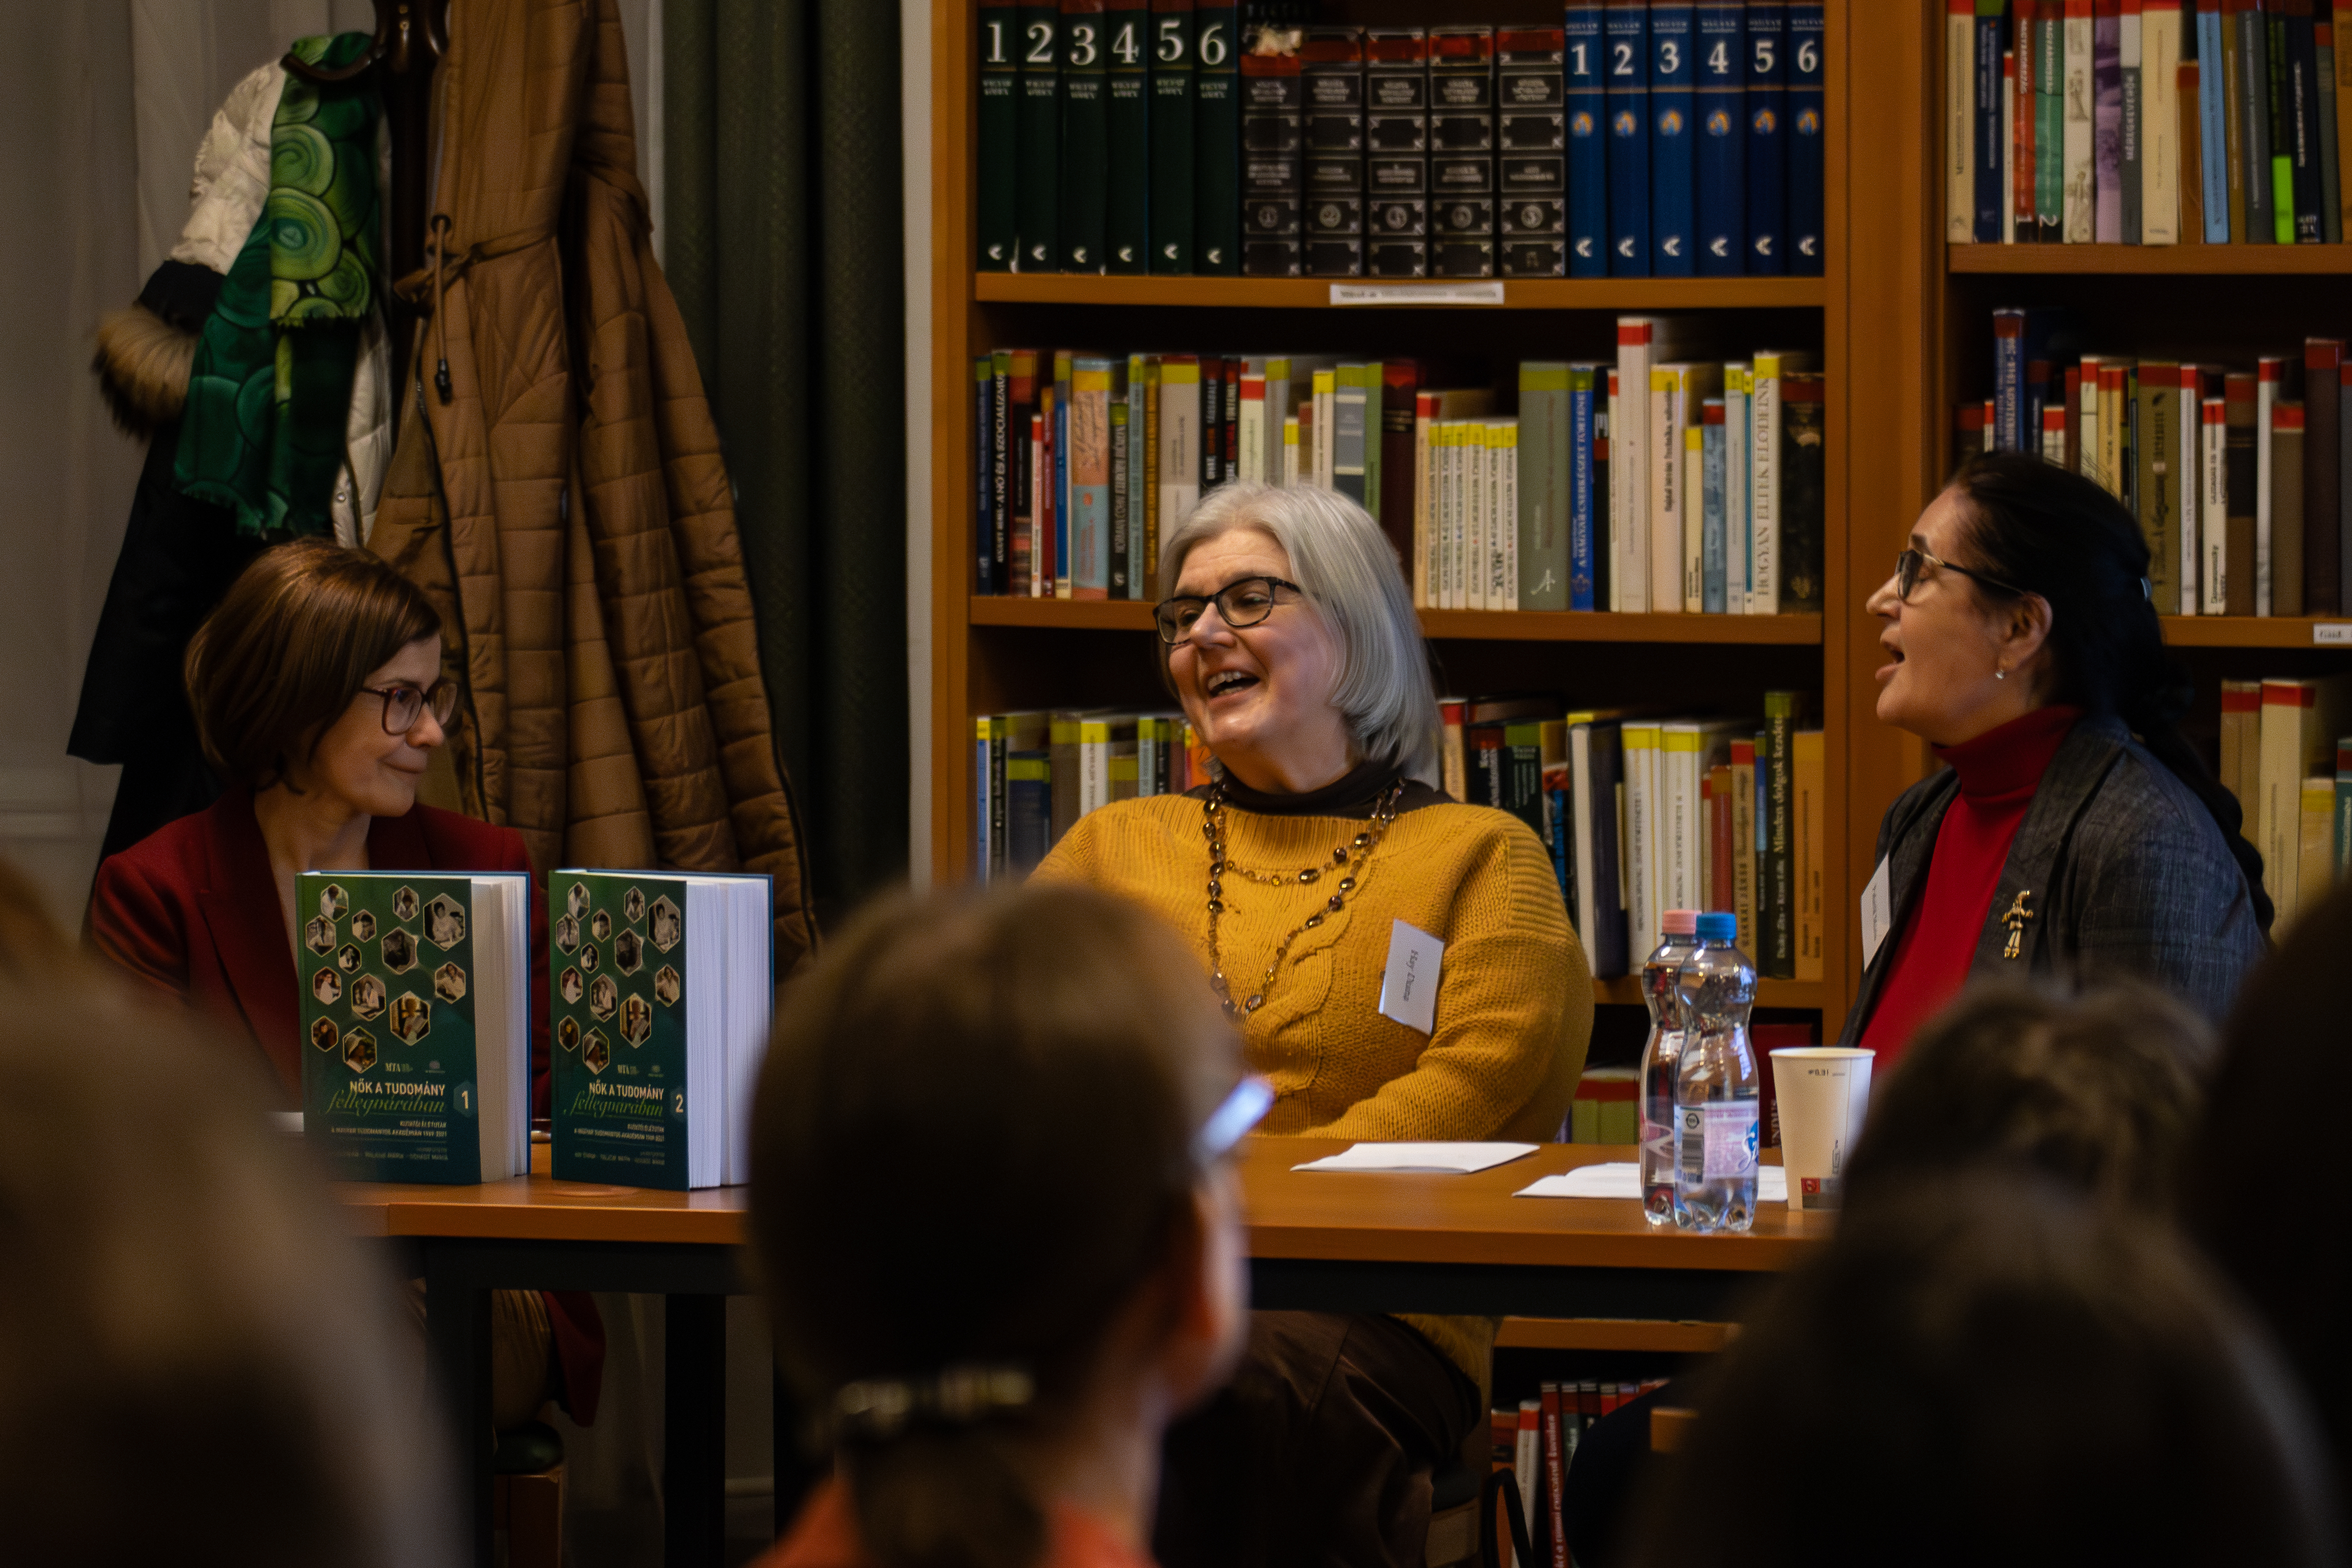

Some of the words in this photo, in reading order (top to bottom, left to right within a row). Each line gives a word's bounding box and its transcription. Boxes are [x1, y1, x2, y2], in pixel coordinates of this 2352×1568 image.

[986, 21, 1006, 63] 1
[1026, 22, 1053, 63] 2
[1070, 23, 1097, 65] 3
[1112, 22, 1140, 64] 4
[1157, 19, 1184, 61] 5
[1199, 23, 1227, 65] 6
[1753, 40, 1774, 73] 5
[1798, 40, 1818, 73] 6
[1571, 43, 1590, 75] 1
[1613, 43, 1634, 75] 2
[1659, 41, 1681, 74] 3
[1708, 41, 1729, 74] 4
[1757, 526, 1769, 596] HOGYAN
[1773, 761, 1788, 803] dolgok
[1773, 804, 1783, 854] Minden
[325, 1089, 445, 1117] fellegvárában
[350, 1078, 373, 1094] NŐK
[375, 1083, 383, 1095] A
[385, 1081, 446, 1097] TUDOMÁNY
[461, 1090, 469, 1110] 1
[589, 1079, 607, 1095] NŐK
[609, 1084, 615, 1096] A
[616, 1084, 664, 1100] TUDOMÁNY
[675, 1094, 684, 1113] 2
